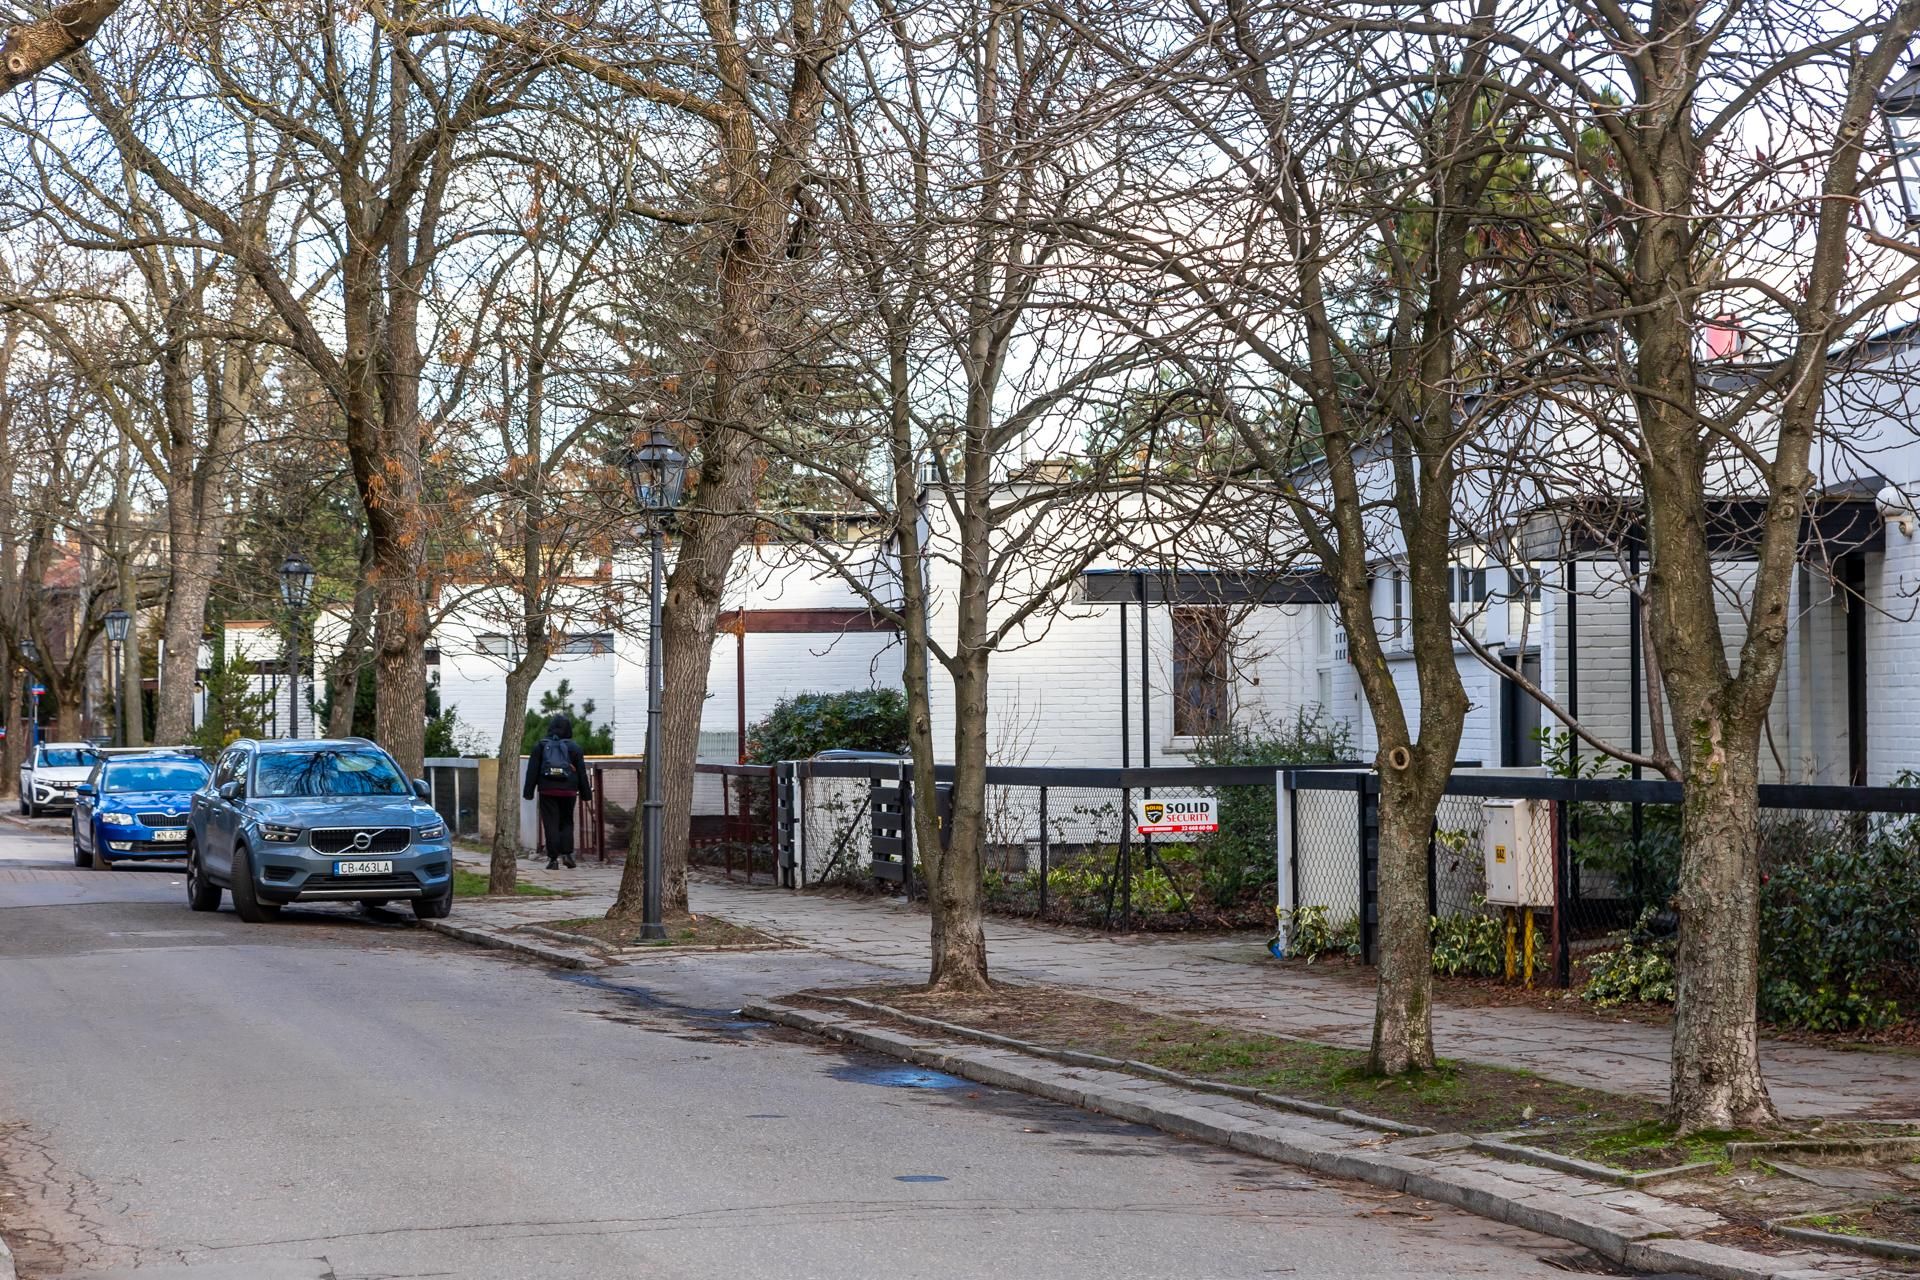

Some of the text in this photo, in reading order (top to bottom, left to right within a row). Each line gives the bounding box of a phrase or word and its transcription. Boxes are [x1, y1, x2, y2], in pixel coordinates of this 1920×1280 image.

[1166, 802, 1210, 814] SOLID
[1166, 813, 1209, 823] SECURITY
[341, 862, 390, 874] CB 463LA
